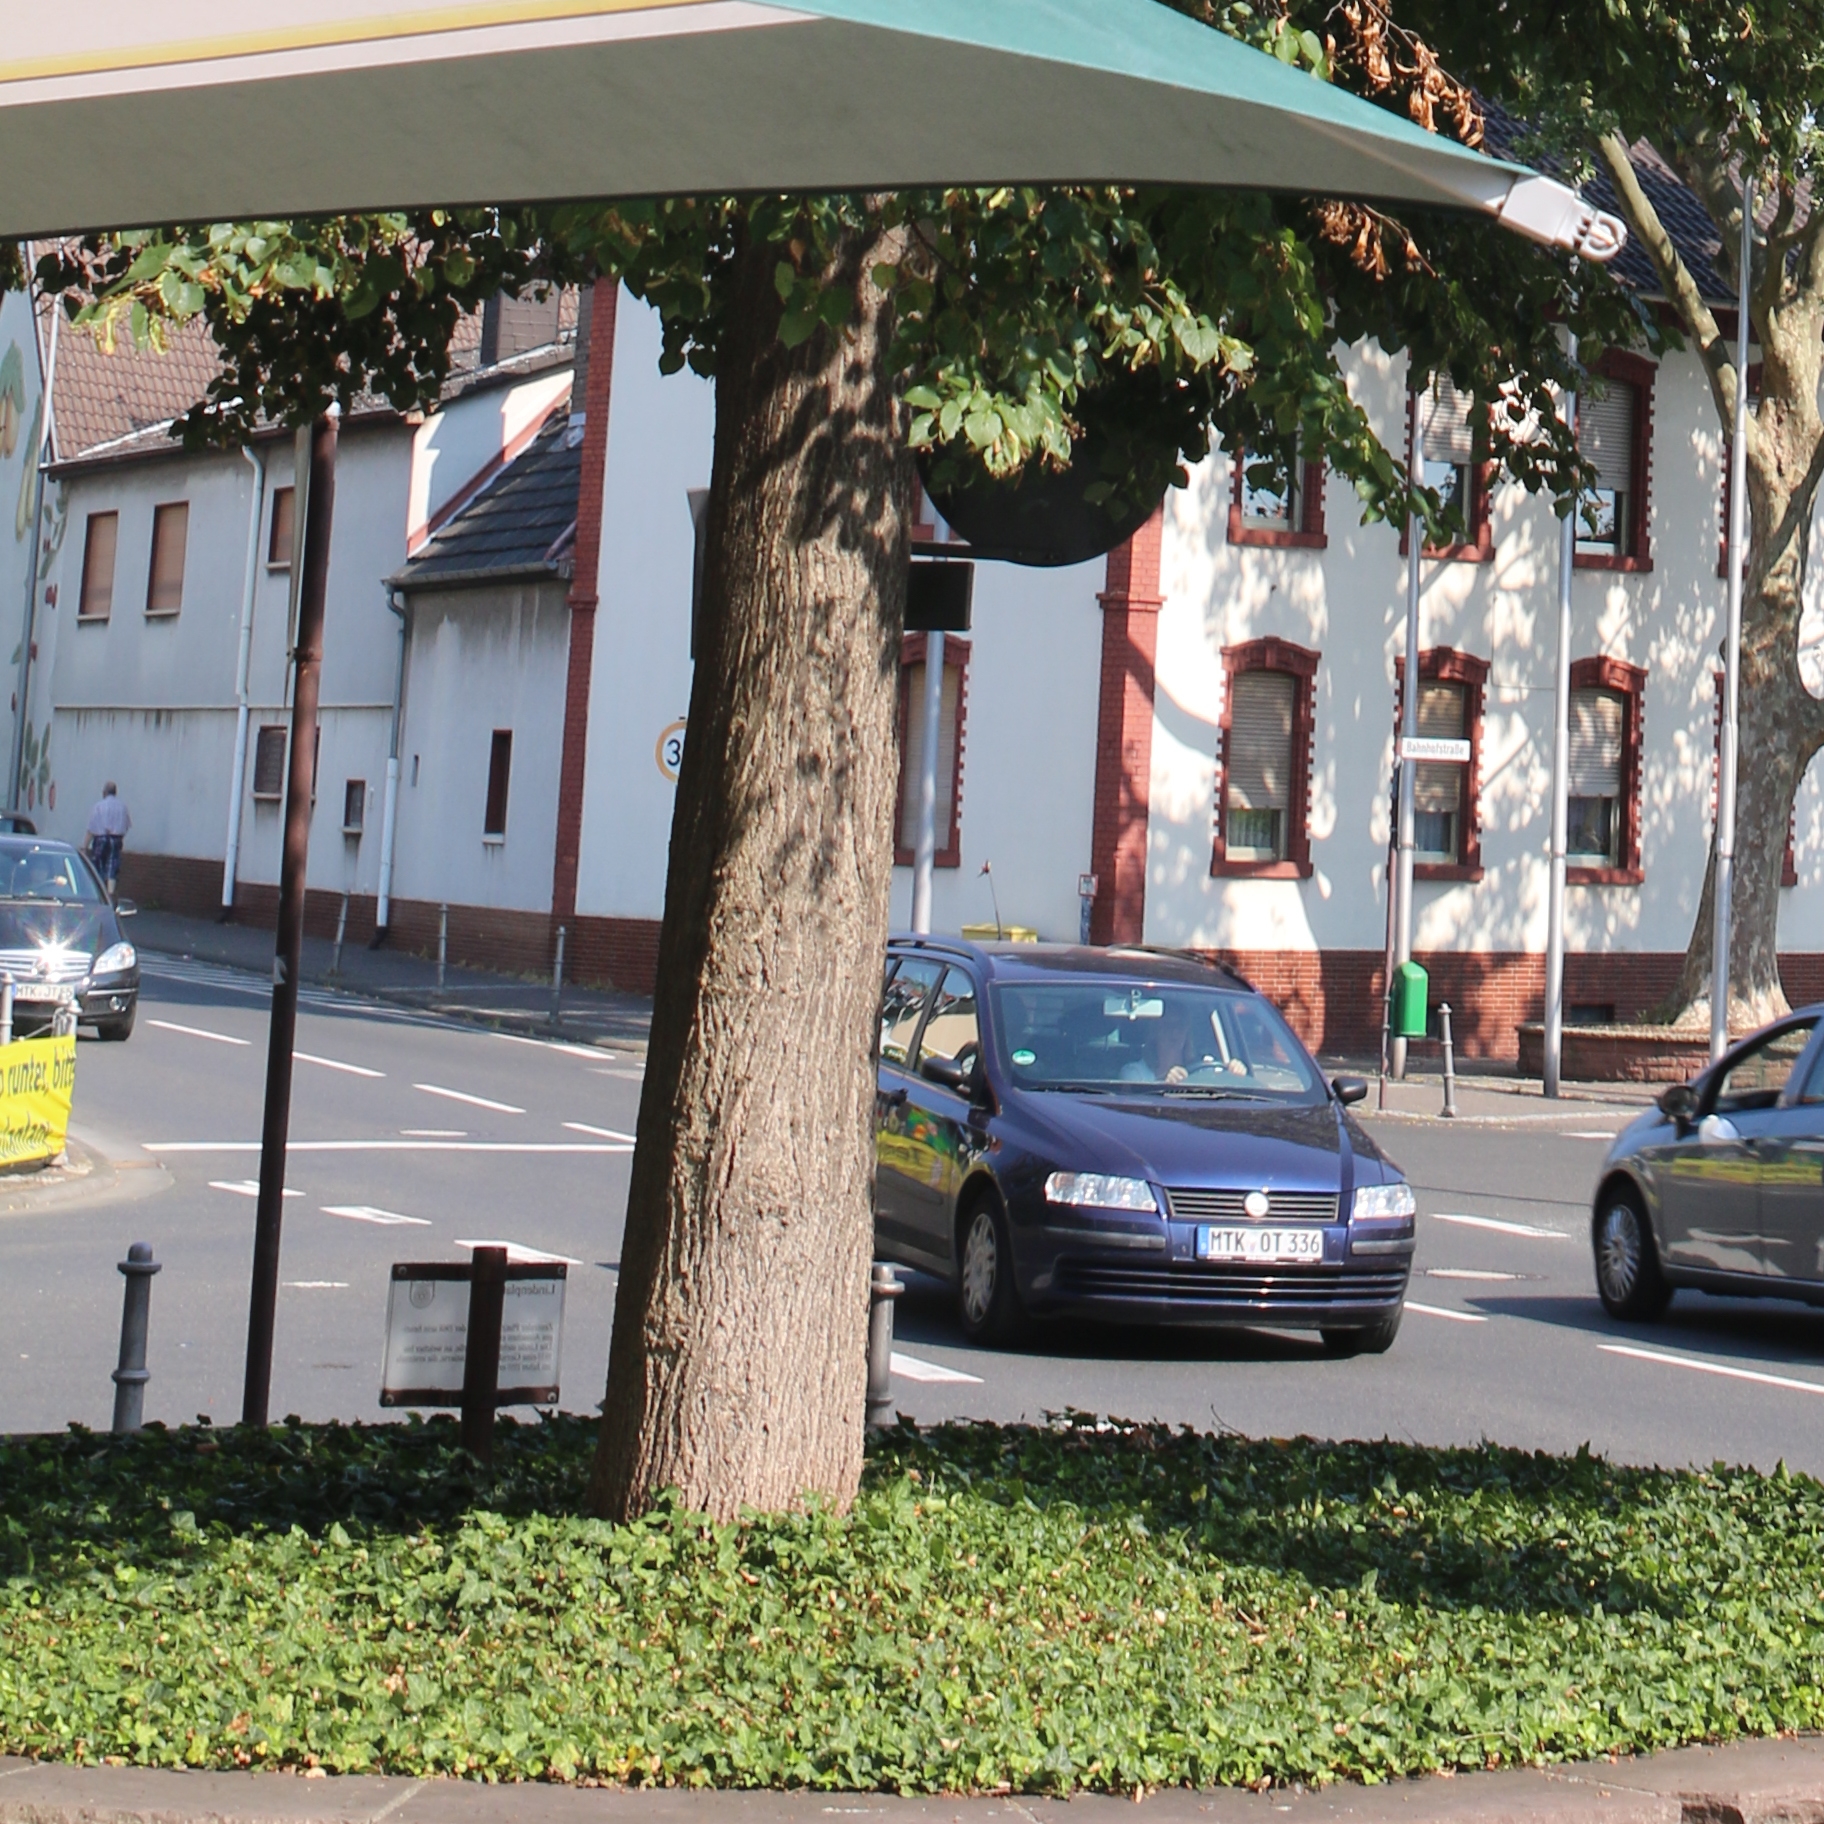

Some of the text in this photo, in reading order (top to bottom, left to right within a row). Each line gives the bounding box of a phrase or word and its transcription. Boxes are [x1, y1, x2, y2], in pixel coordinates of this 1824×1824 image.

[666, 738, 684, 766] 3
[1406, 740, 1465, 755] Bahnhofstraße
[1211, 1231, 1246, 1252] MTK
[1287, 1232, 1320, 1254] 336
